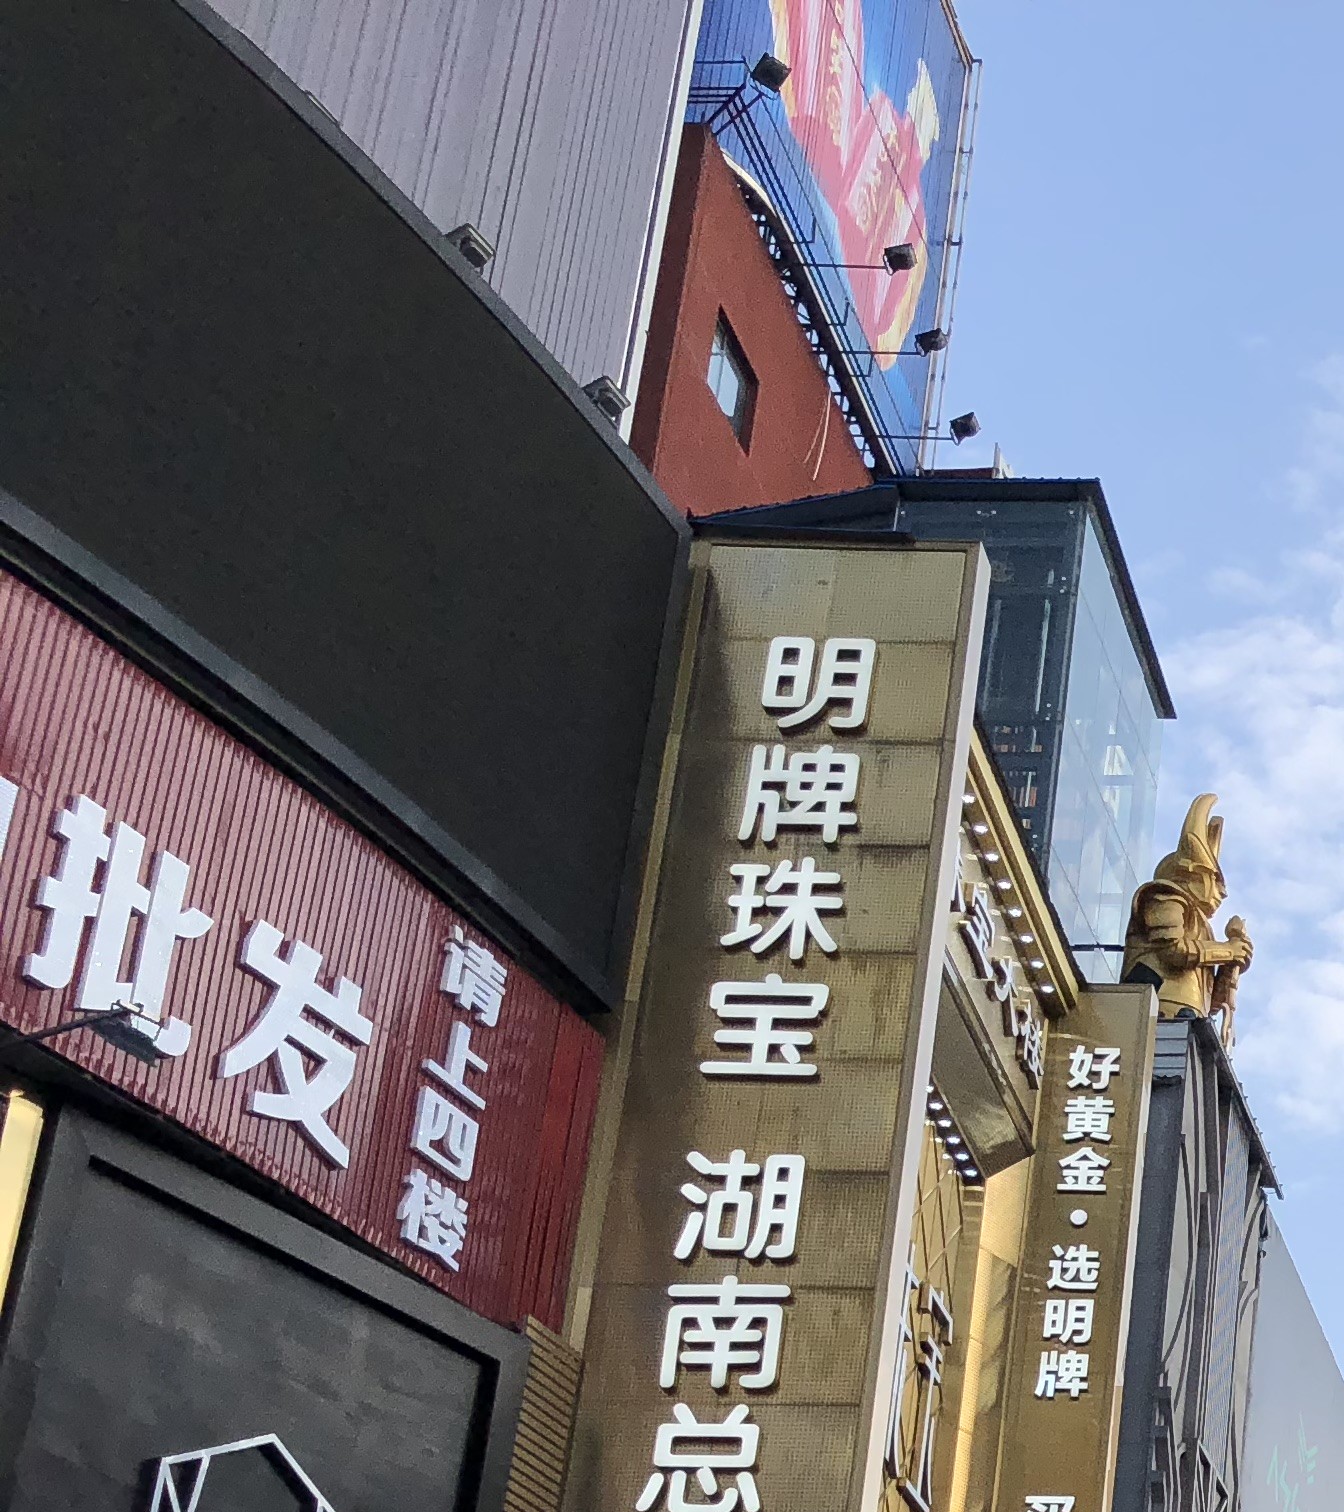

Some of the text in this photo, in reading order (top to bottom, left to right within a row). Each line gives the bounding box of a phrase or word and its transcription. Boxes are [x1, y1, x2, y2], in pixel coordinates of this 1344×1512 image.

[0, 775, 374, 1170] 批发
[700, 635, 877, 1076] 明牌珠宝
[397, 924, 507, 1272] 请上四楼
